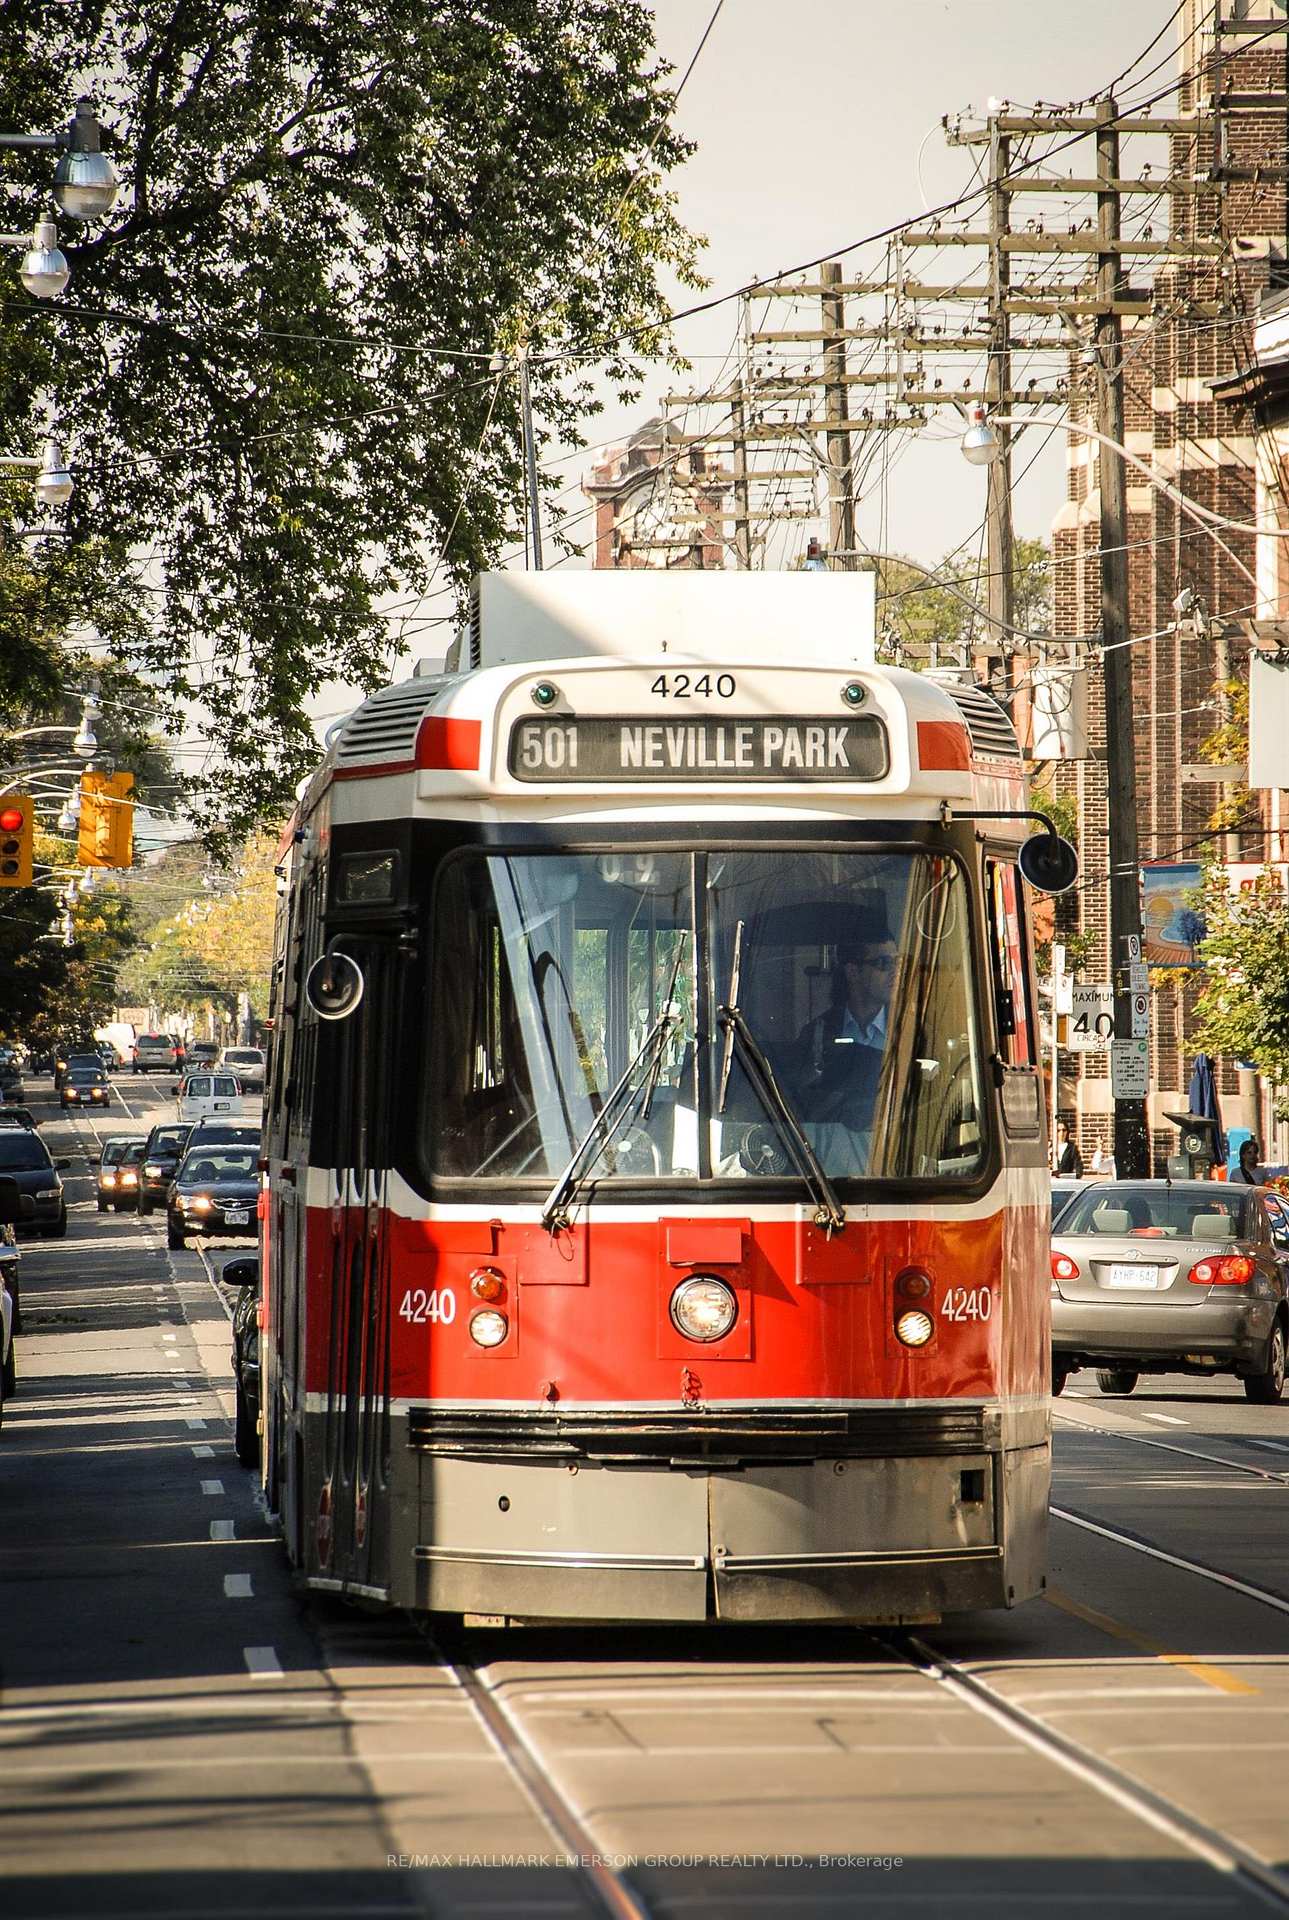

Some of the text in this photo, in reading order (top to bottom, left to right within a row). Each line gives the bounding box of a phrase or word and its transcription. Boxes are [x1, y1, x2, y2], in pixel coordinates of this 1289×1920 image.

[651, 673, 736, 698] 4240
[522, 726, 850, 769] 501 NEVILLE PARK
[1073, 1012, 1114, 1039] 40
[399, 1288, 456, 1325] 4240
[941, 1286, 991, 1322] 4240
